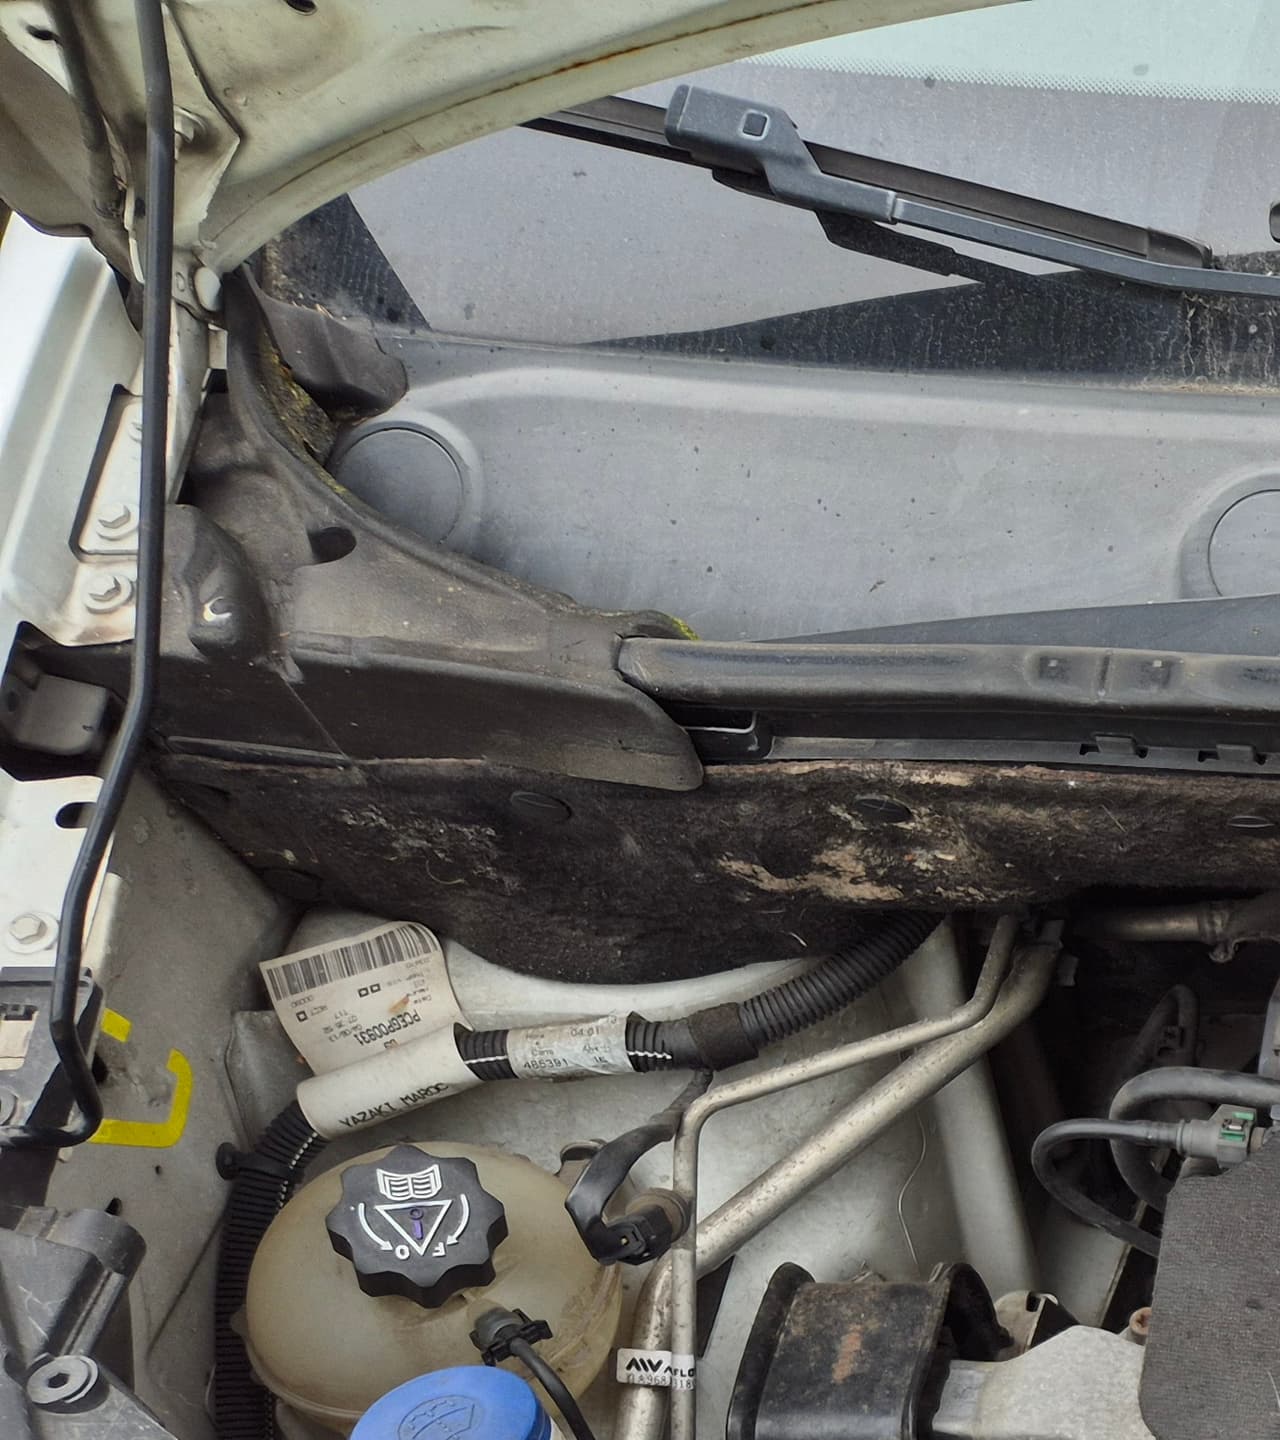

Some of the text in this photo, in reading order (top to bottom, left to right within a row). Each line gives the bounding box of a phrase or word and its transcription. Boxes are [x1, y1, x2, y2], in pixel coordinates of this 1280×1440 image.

[352, 1008, 421, 1046] PCEGP00931
[338, 1082, 448, 1127] YAZAKI MAROC
